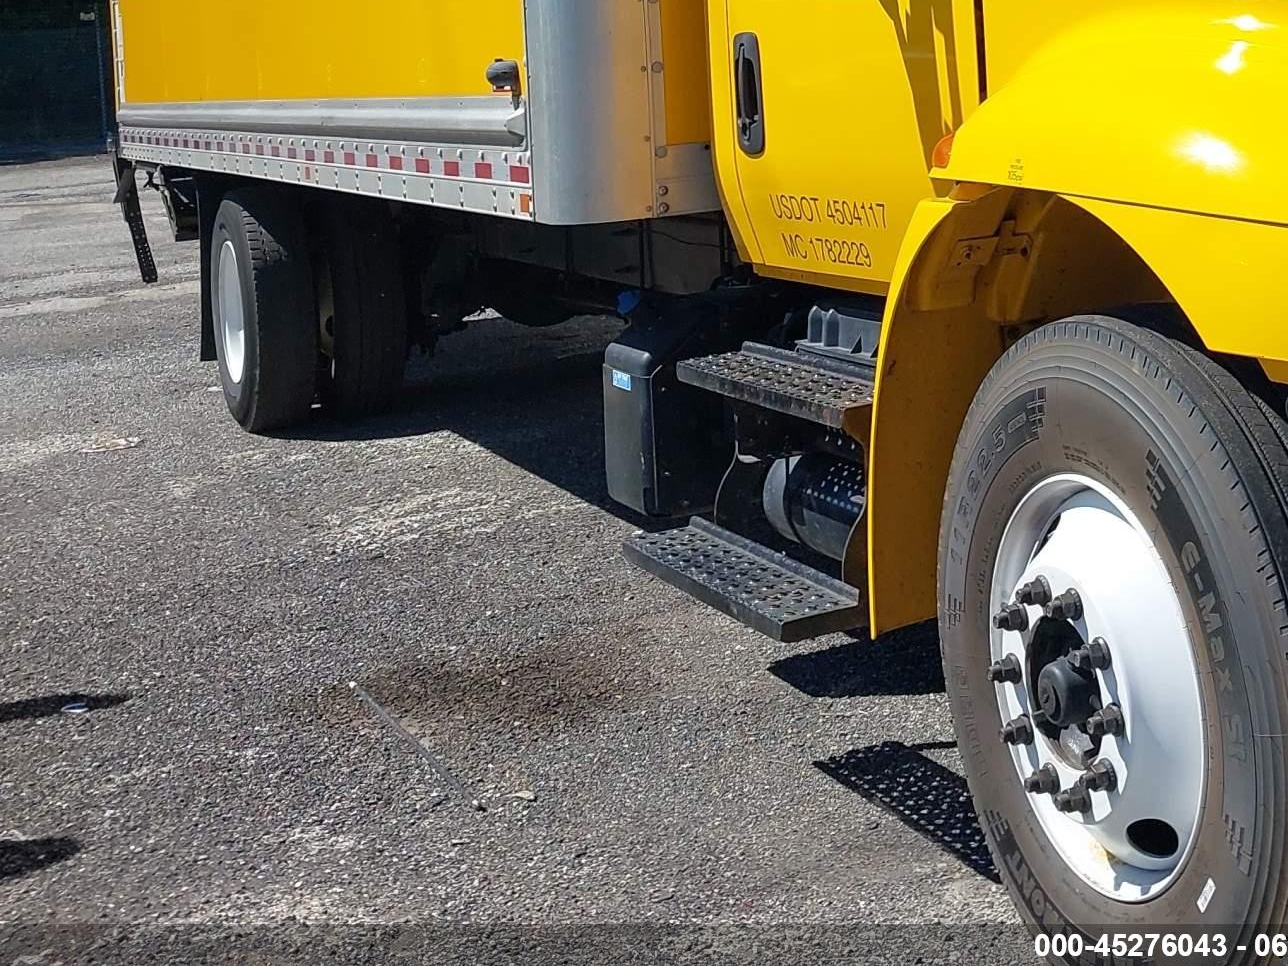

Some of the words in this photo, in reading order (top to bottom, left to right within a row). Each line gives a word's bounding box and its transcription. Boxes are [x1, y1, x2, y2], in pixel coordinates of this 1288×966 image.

[770, 194, 822, 222] USDOT
[826, 199, 887, 228] 4504117
[781, 233, 808, 259] MC
[809, 238, 872, 267] 1782229
